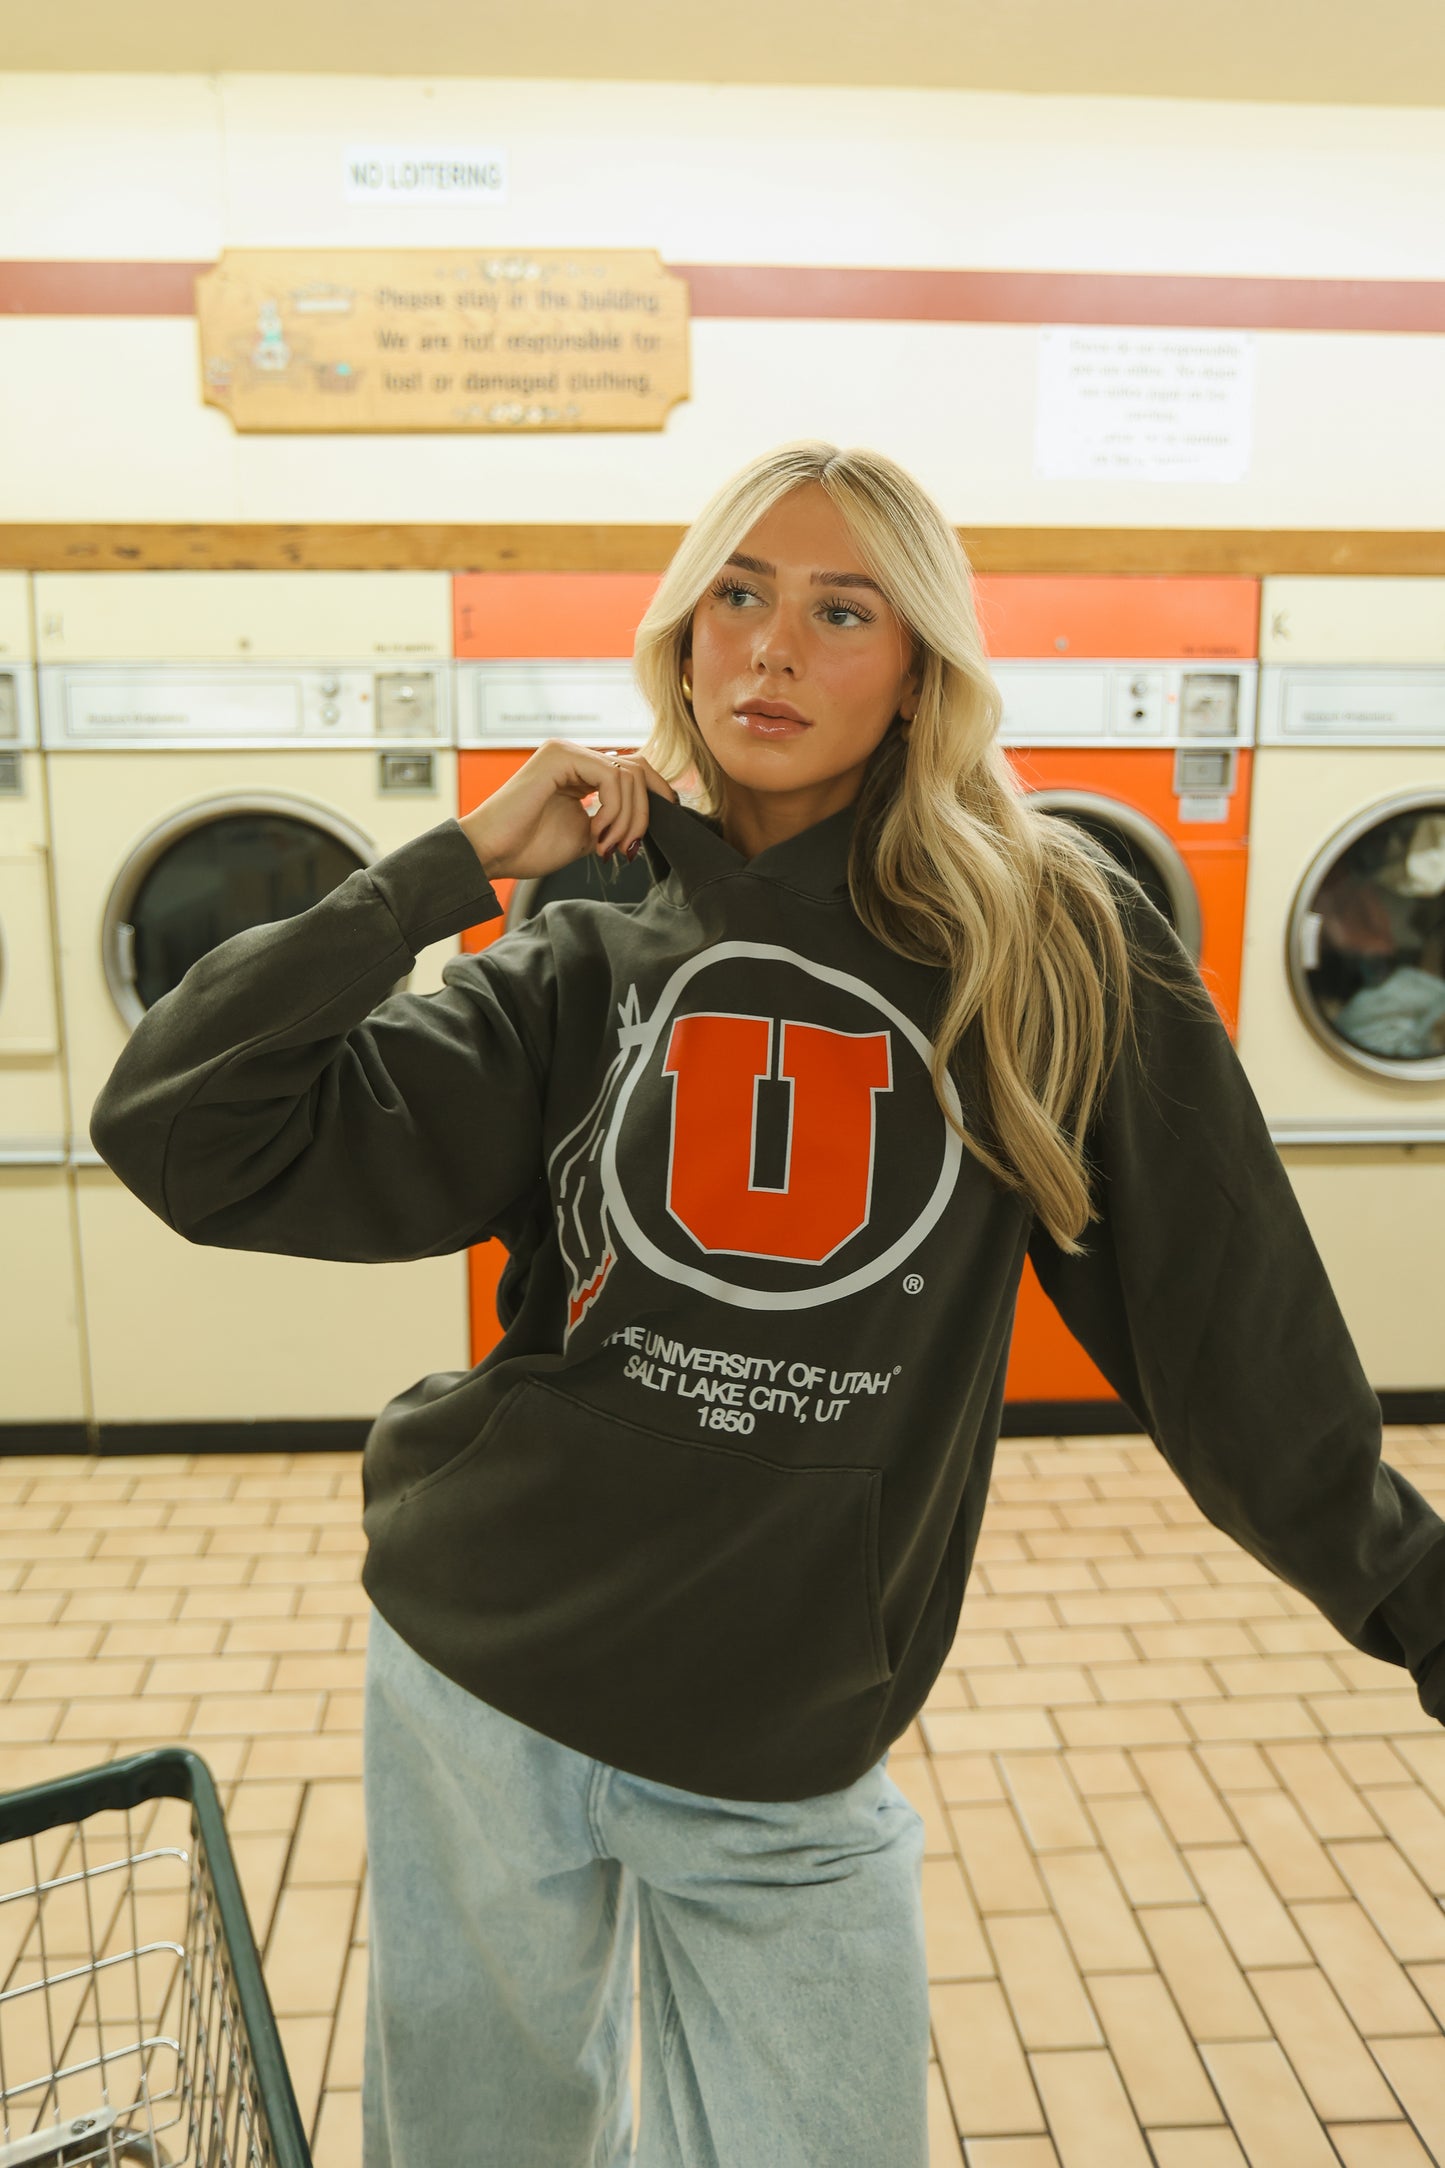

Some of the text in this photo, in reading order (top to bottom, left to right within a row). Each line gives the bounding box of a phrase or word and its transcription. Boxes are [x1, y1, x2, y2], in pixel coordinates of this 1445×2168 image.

[350, 160, 502, 190] NO LOITERING
[377, 287, 443, 309] Please
[456, 289, 498, 313] stay
[505, 288, 524, 310] in
[536, 288, 569, 310] the
[376, 329, 660, 353] We are not responsible for
[383, 370, 422, 392] lost
[431, 373, 453, 392] or
[462, 370, 558, 396] damaged
[661, 1011, 894, 1266] U
[645, 1331, 786, 1382] UNIVERSITY
[787, 1362, 826, 1390] OF
[623, 1354, 850, 1424] SALT LAKE CITY, UT
[697, 1406, 756, 1434] 1850
